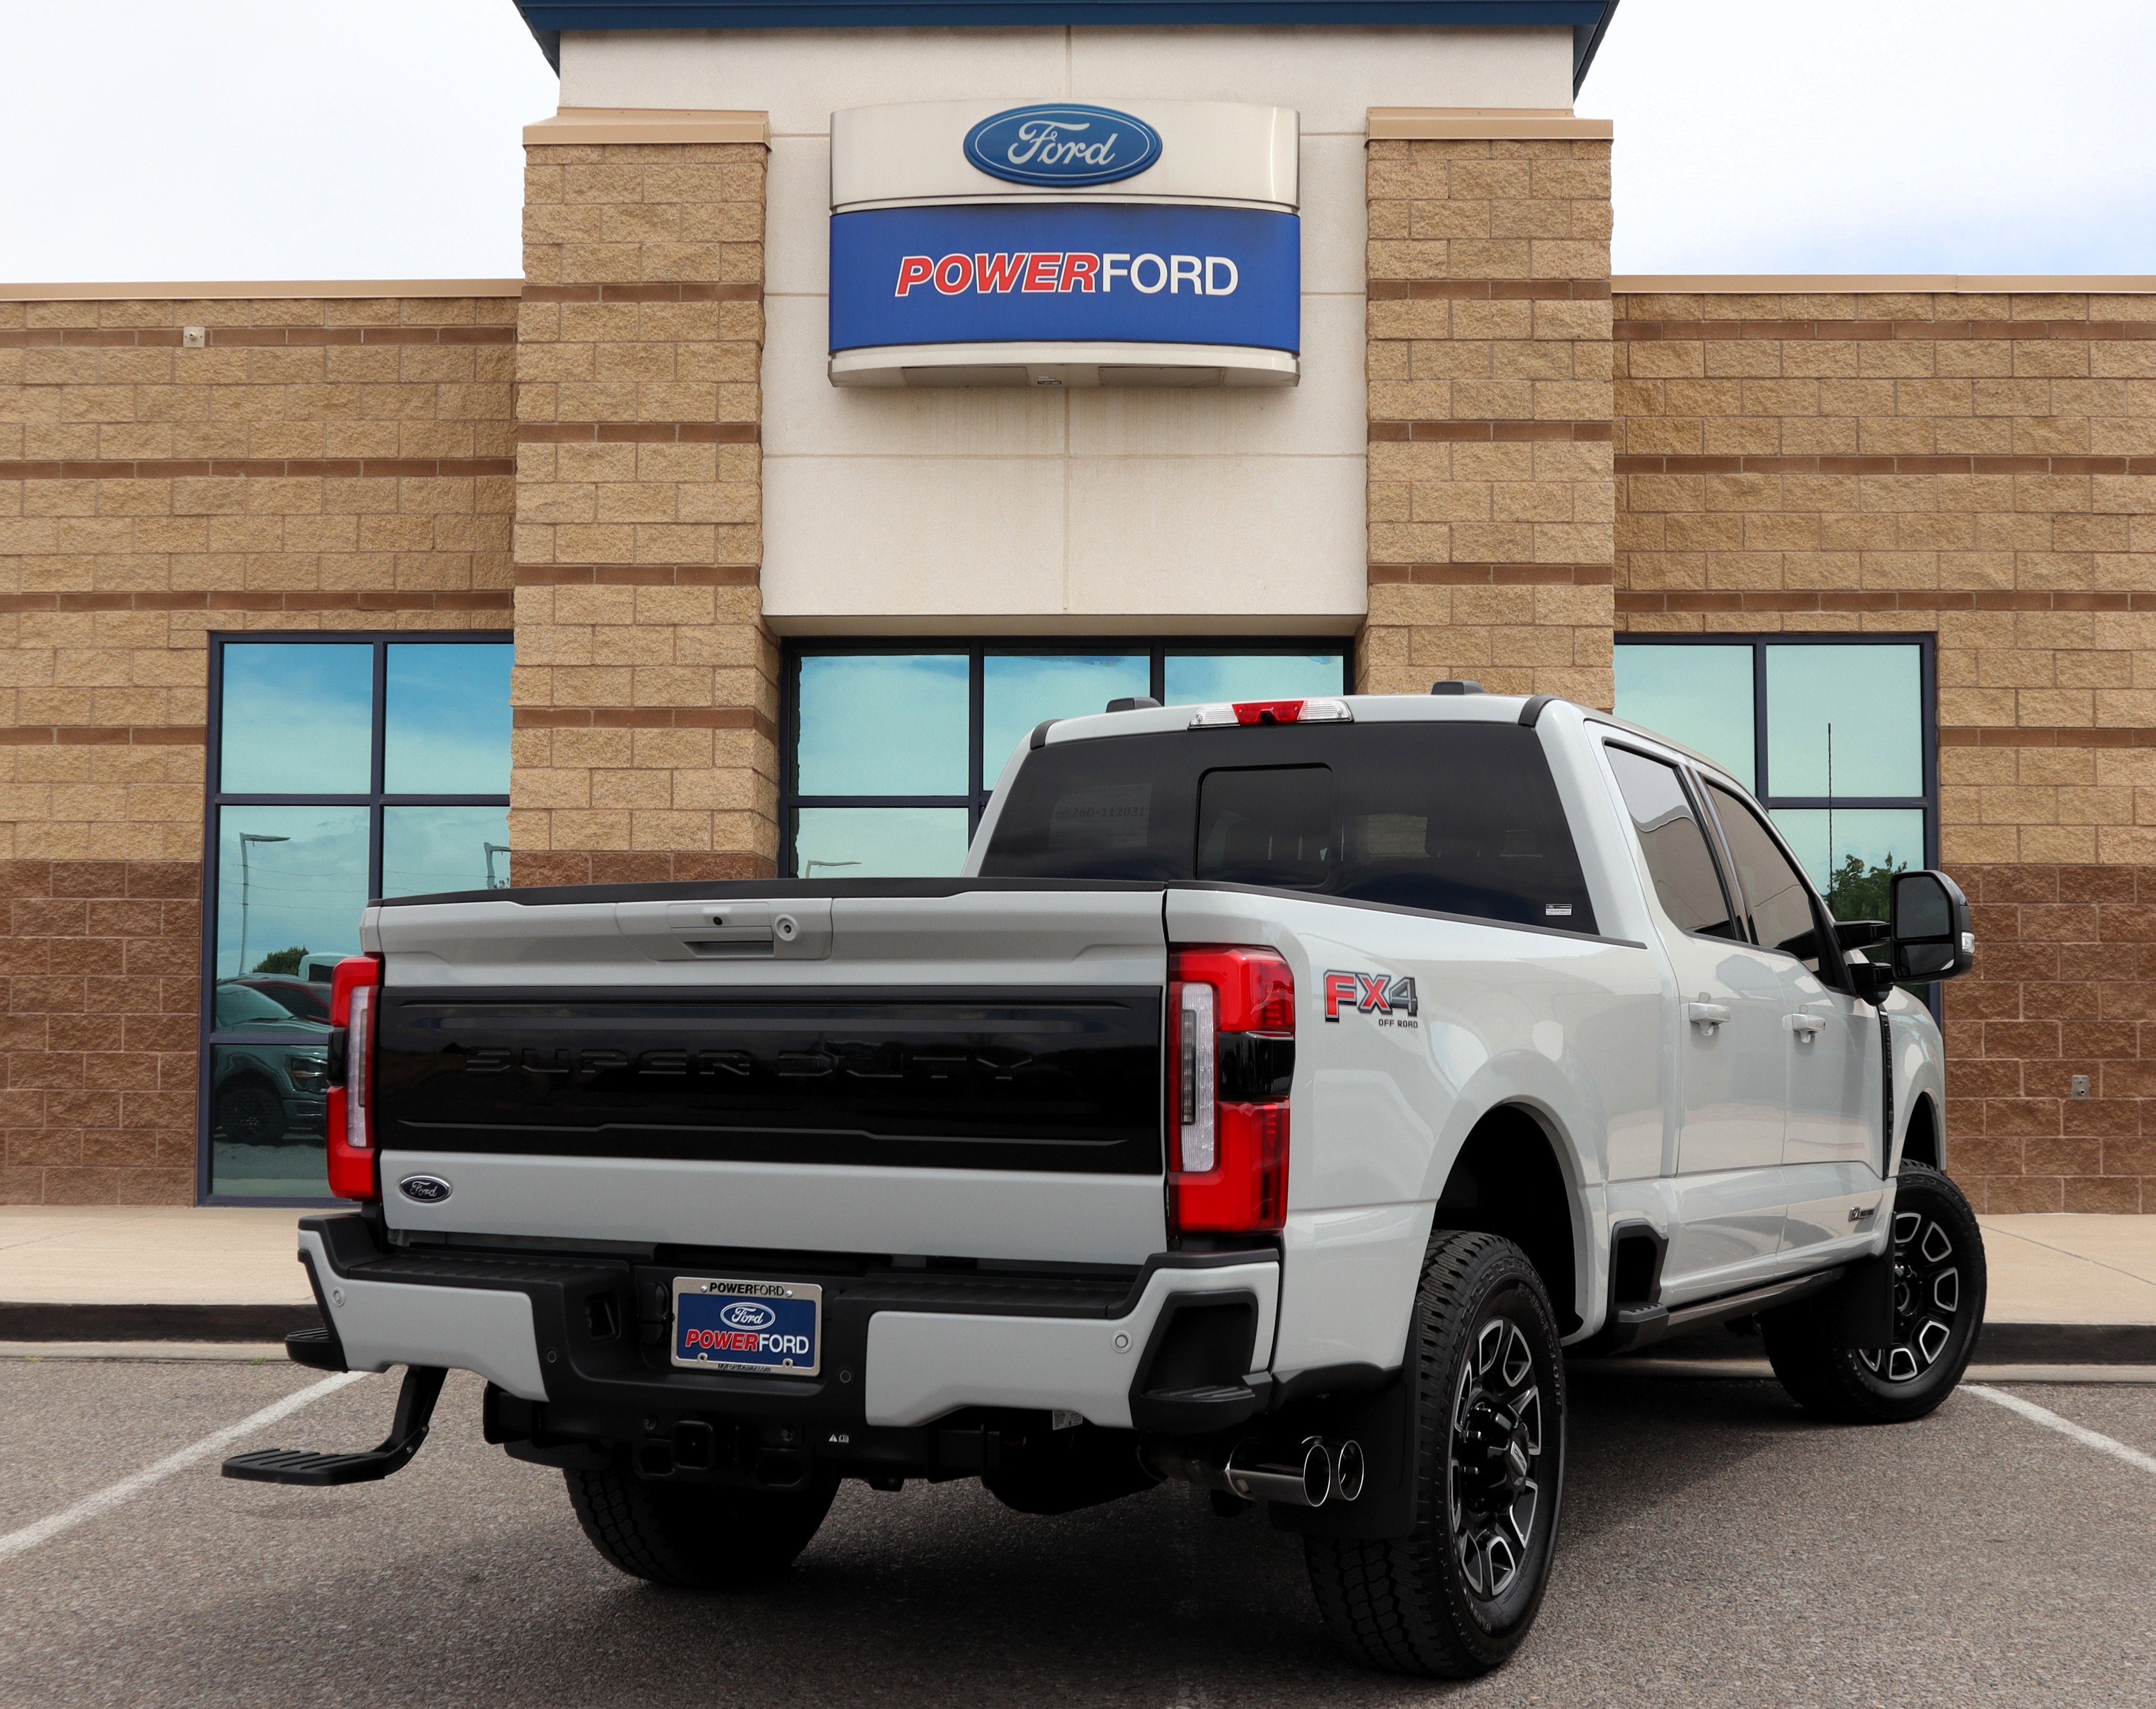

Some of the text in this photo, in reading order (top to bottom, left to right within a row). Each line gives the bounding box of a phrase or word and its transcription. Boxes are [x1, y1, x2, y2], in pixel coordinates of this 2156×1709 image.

[1007, 120, 1119, 166] Ford
[1323, 970, 1419, 1023] FX4
[1378, 1019, 1419, 1028] OFF ROAD
[466, 1047, 1032, 1080] SUPER DUTY
[410, 1181, 438, 1197] Ford
[731, 1307, 764, 1324] Ford
